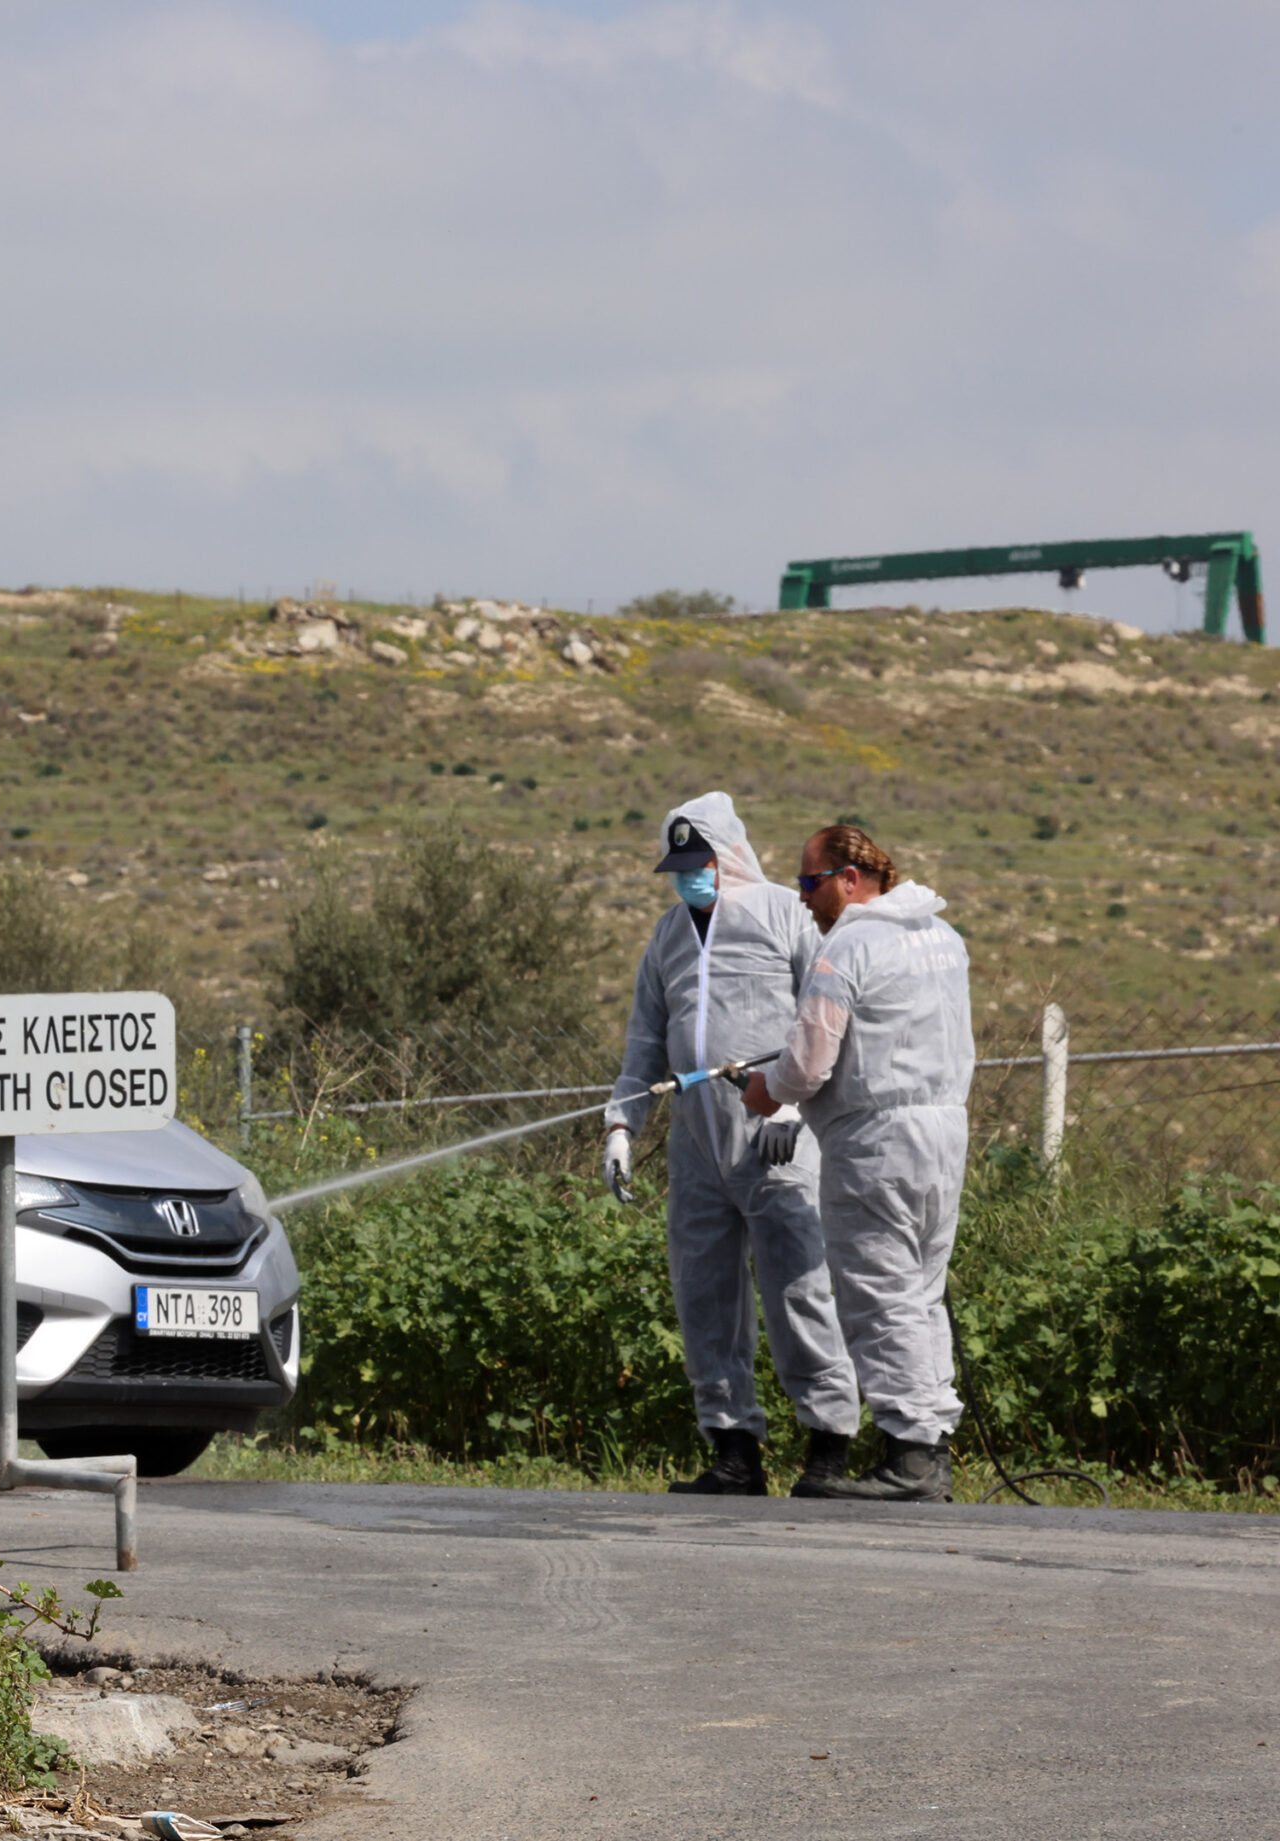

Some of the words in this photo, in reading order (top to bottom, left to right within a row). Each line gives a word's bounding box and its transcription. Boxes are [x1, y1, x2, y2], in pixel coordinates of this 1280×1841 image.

[23, 1012, 157, 1055] ΚΛΕΙΣΤΟΣ
[45, 1067, 168, 1111] CLOSED
[156, 1293, 196, 1325] NTA
[208, 1294, 243, 1327] 398
